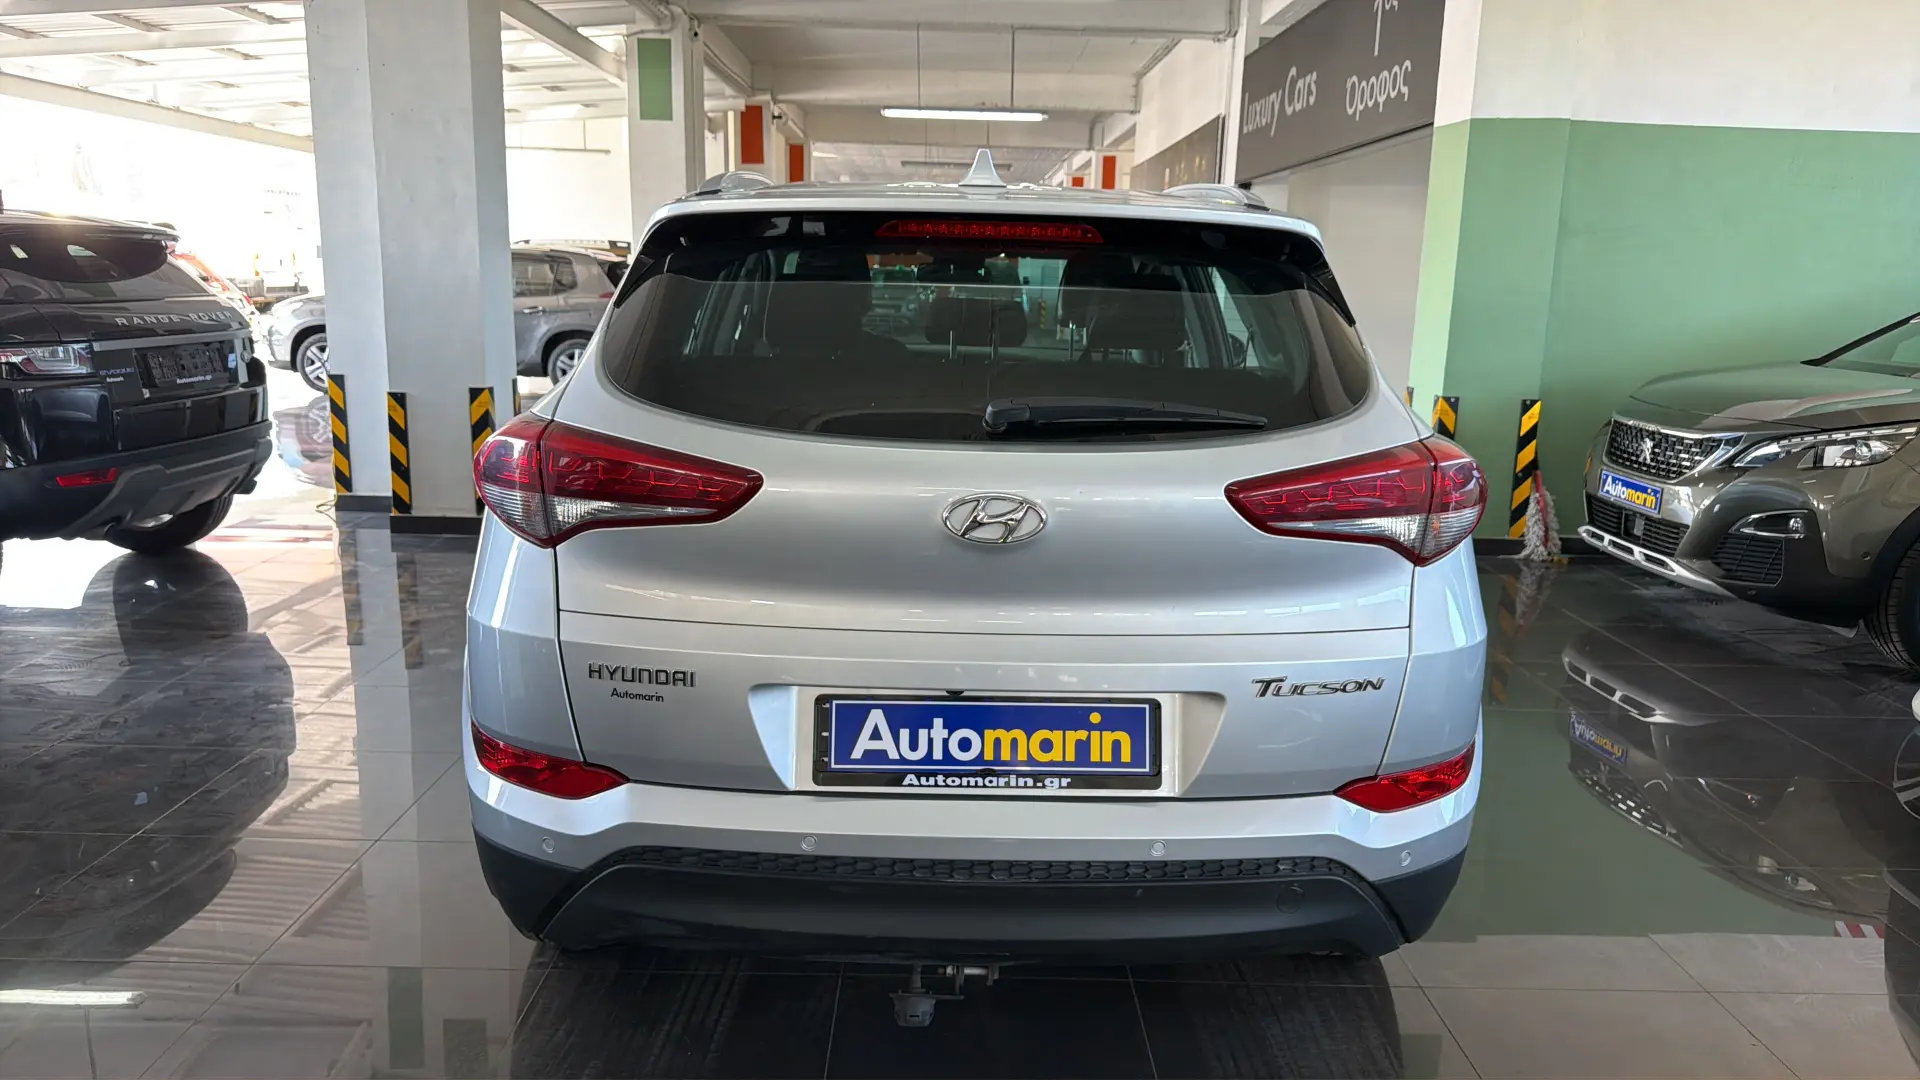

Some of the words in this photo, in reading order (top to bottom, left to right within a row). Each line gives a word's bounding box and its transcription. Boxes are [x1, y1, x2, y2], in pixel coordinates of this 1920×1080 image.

[1243, 89, 1282, 137] Luxury
[1284, 65, 1317, 116] Cars
[1346, 60, 1411, 121] Όροφος
[115, 313, 181, 326] RANGE
[188, 310, 233, 321] ROVER
[1603, 475, 1656, 509] Automarin
[588, 661, 697, 687] HYUNDAI
[610, 688, 664, 702] Automarin
[850, 708, 1131, 763] Automarin
[901, 774, 1071, 790] Automarin.gr
